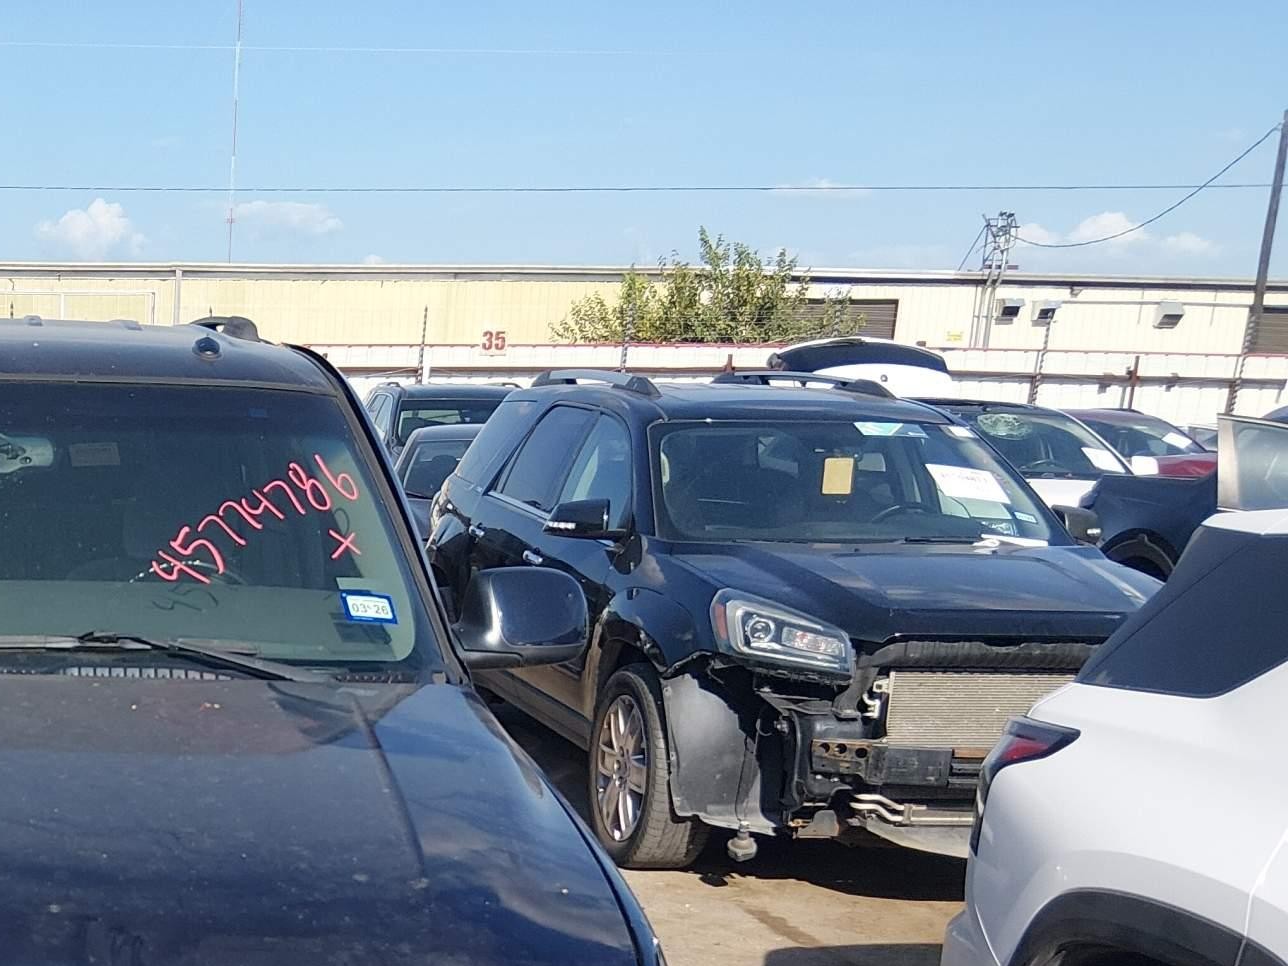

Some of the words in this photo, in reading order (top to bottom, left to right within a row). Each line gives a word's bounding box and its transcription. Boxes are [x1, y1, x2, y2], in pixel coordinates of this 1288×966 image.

[482, 330, 506, 350] 35
[152, 454, 359, 584] 45774786
[373, 604, 389, 616] 26
